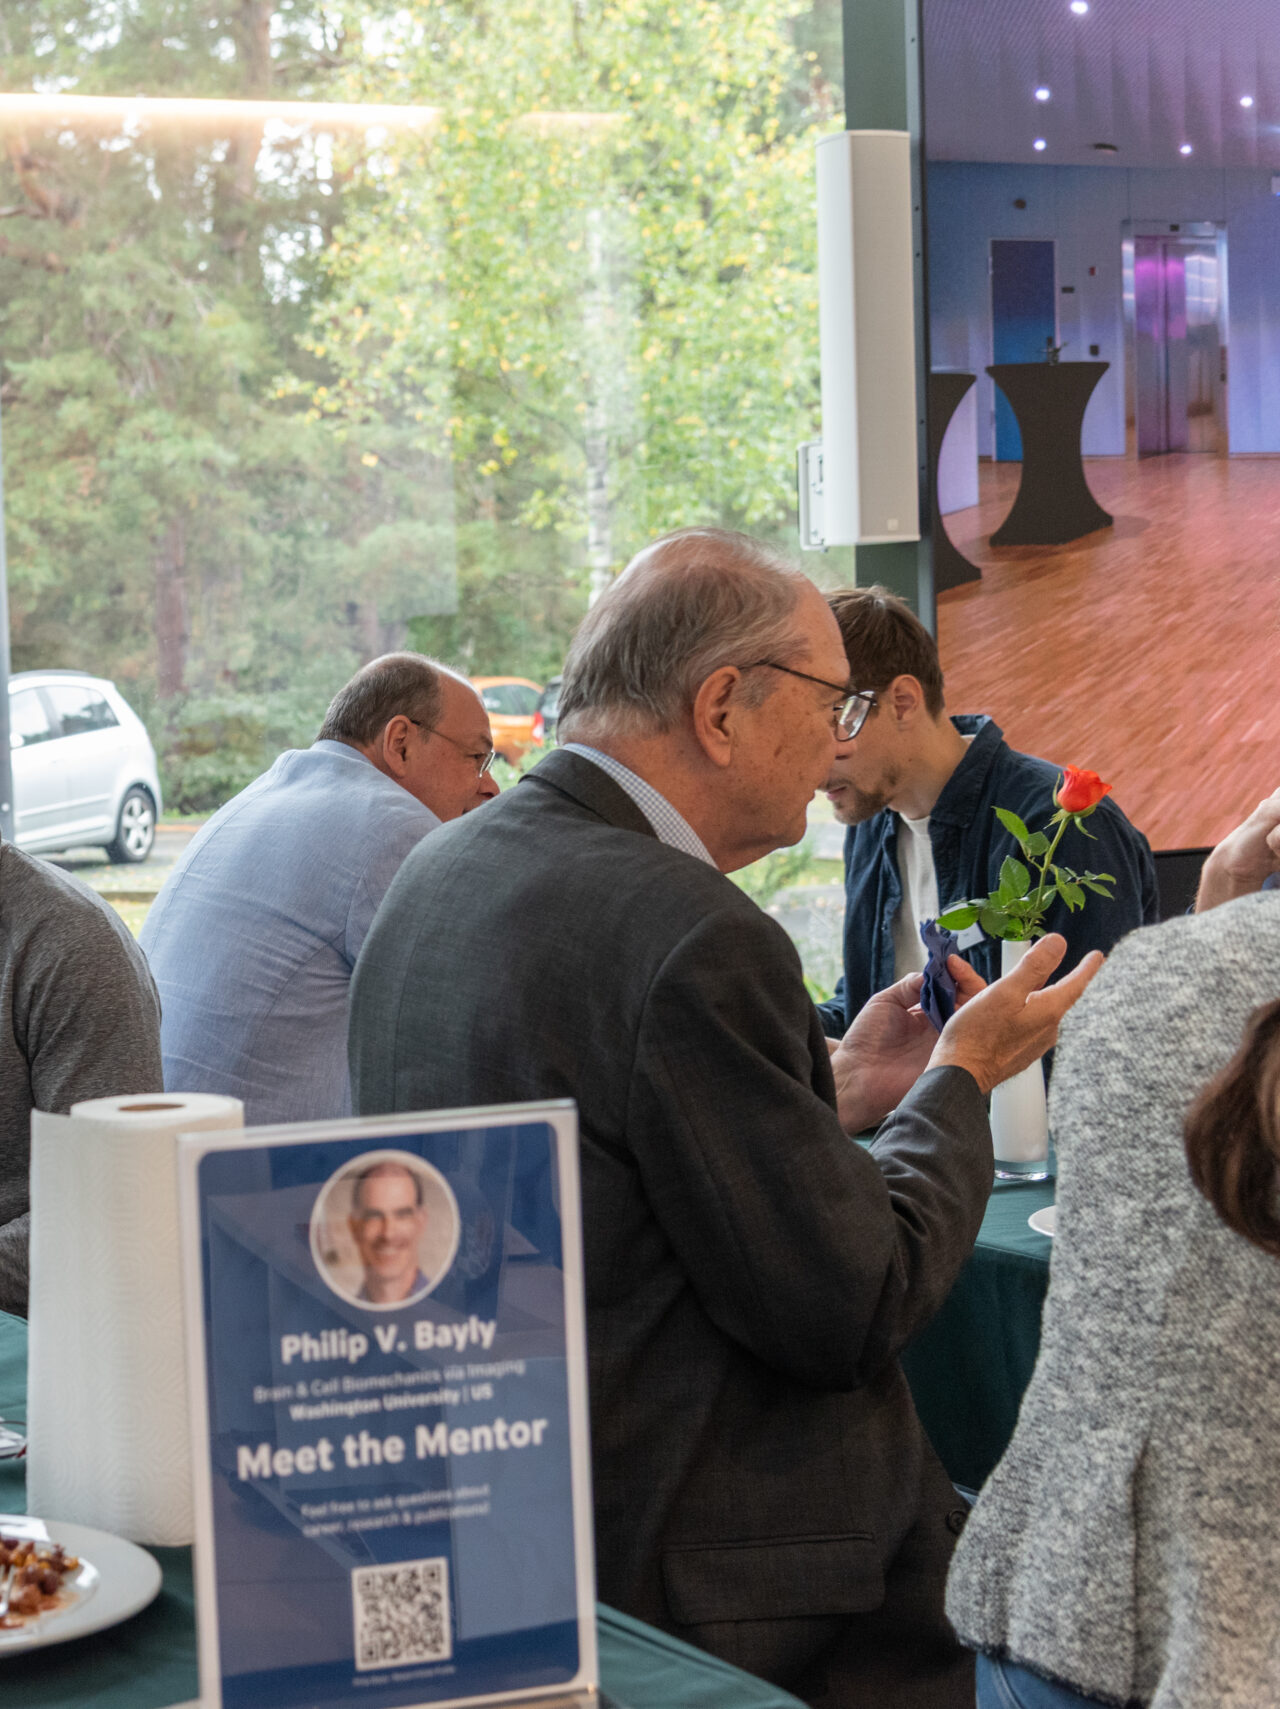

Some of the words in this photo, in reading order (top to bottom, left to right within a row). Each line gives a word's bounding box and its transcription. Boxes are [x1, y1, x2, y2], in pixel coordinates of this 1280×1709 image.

[282, 1328, 368, 1365] Philip
[374, 1323, 408, 1355] V.
[414, 1314, 498, 1352] Bayly
[253, 1384, 294, 1404] Brain
[296, 1380, 308, 1399] &
[310, 1376, 339, 1397] Cell
[342, 1369, 441, 1393] Biomechanics
[444, 1363, 466, 1381] via
[467, 1359, 527, 1380] Imaging
[289, 1397, 381, 1422] Washington
[383, 1387, 461, 1411] University
[471, 1382, 494, 1402] US
[237, 1437, 336, 1481] Meet
[342, 1429, 406, 1468] the
[416, 1417, 549, 1460] Mentor
[395, 1489, 452, 1508] questions
